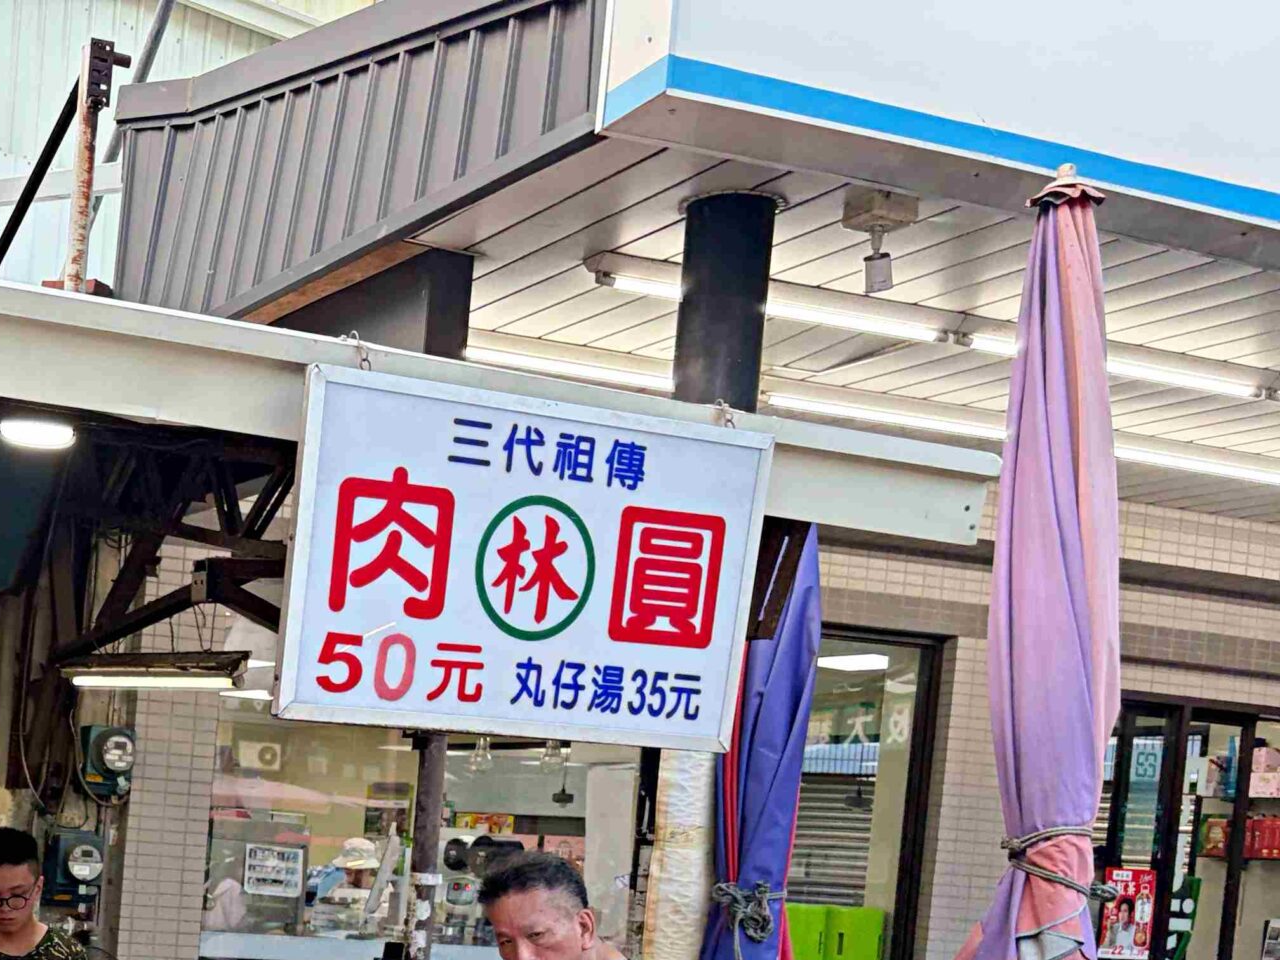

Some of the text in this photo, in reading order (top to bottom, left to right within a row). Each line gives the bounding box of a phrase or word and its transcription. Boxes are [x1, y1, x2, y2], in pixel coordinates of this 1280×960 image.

[449, 419, 645, 491] 三代祖傳
[316, 631, 484, 702] 50元
[511, 657, 700, 720] 丸仔湯35元
